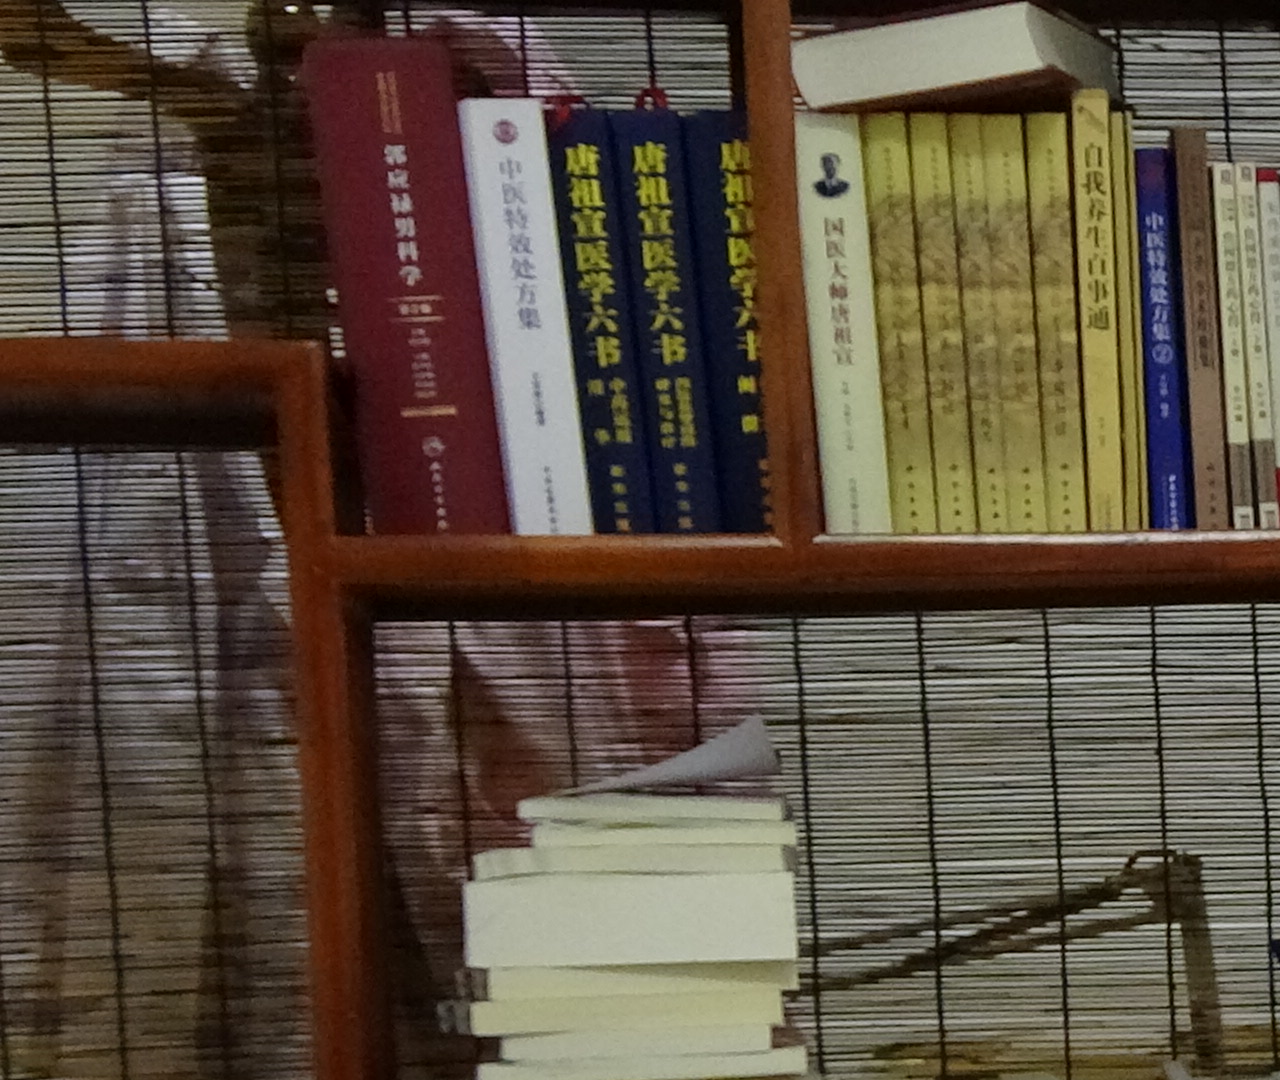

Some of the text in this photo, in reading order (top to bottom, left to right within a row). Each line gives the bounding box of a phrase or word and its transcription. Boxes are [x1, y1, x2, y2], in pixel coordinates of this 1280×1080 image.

[565, 143, 620, 368] 唐祖宣医学六书
[633, 141, 686, 365] 唐祖宣医学六书
